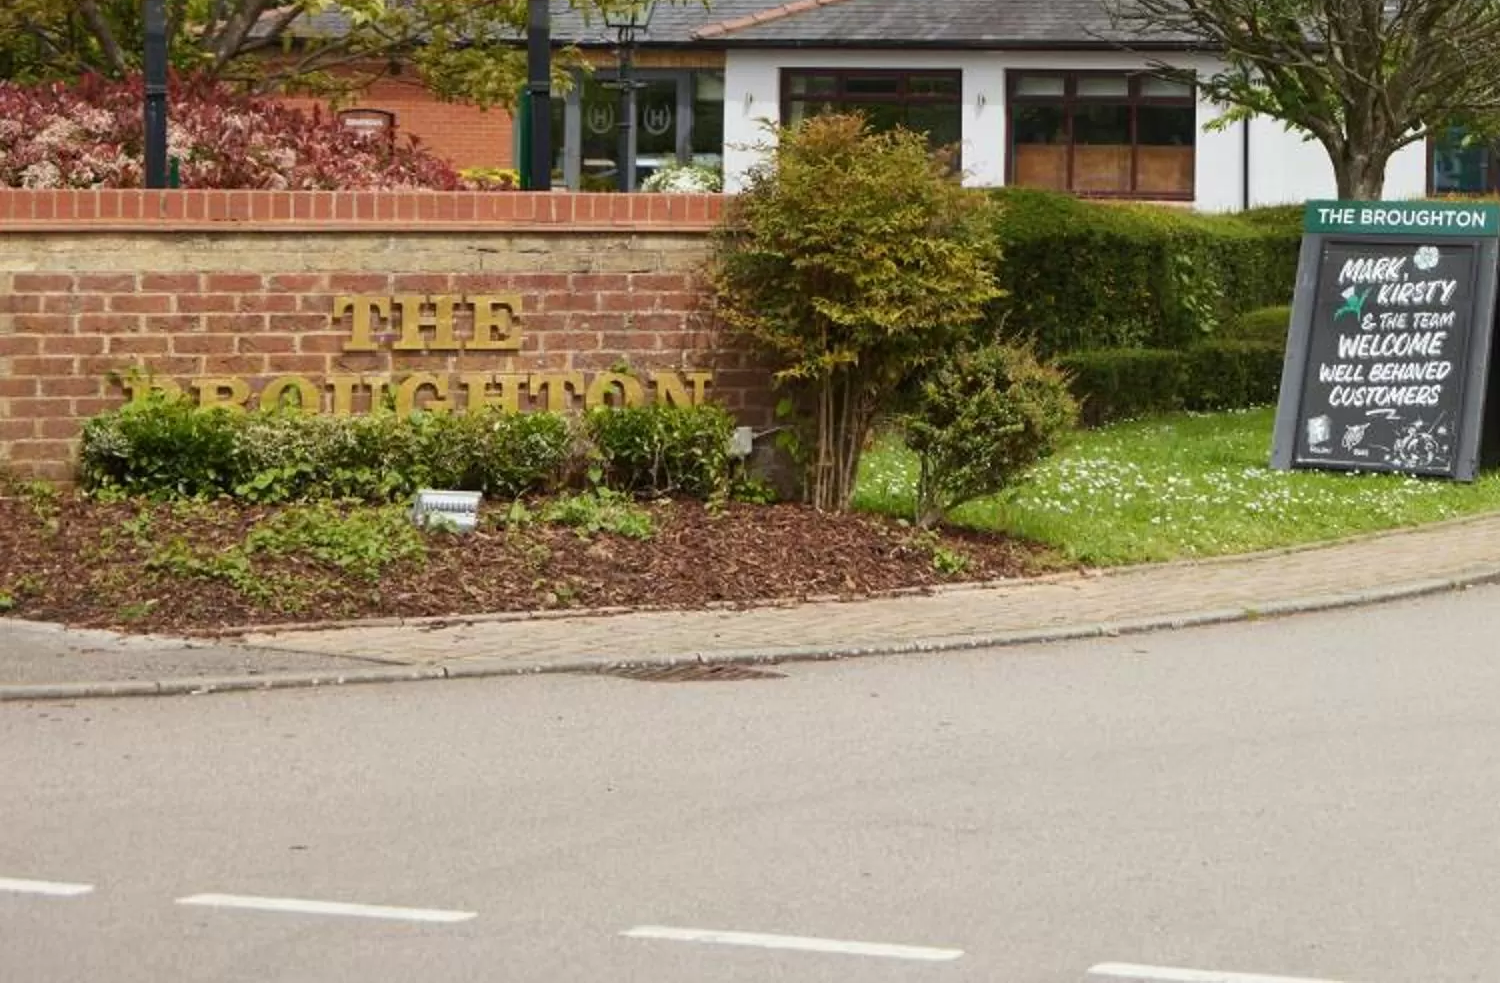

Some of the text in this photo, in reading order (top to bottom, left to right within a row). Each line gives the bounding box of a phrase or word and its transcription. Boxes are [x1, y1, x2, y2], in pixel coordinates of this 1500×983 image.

[1318, 208, 1486, 227] THE BROUGHTON
[1376, 280, 1456, 305] KIRSTY
[332, 295, 523, 351] THE
[1361, 311, 1456, 330] & THE TEAM
[1337, 332, 1446, 358] WELCOME
[1318, 361, 1452, 383] WELL BEHAVED
[1328, 384, 1443, 408] CUSTOMERS
